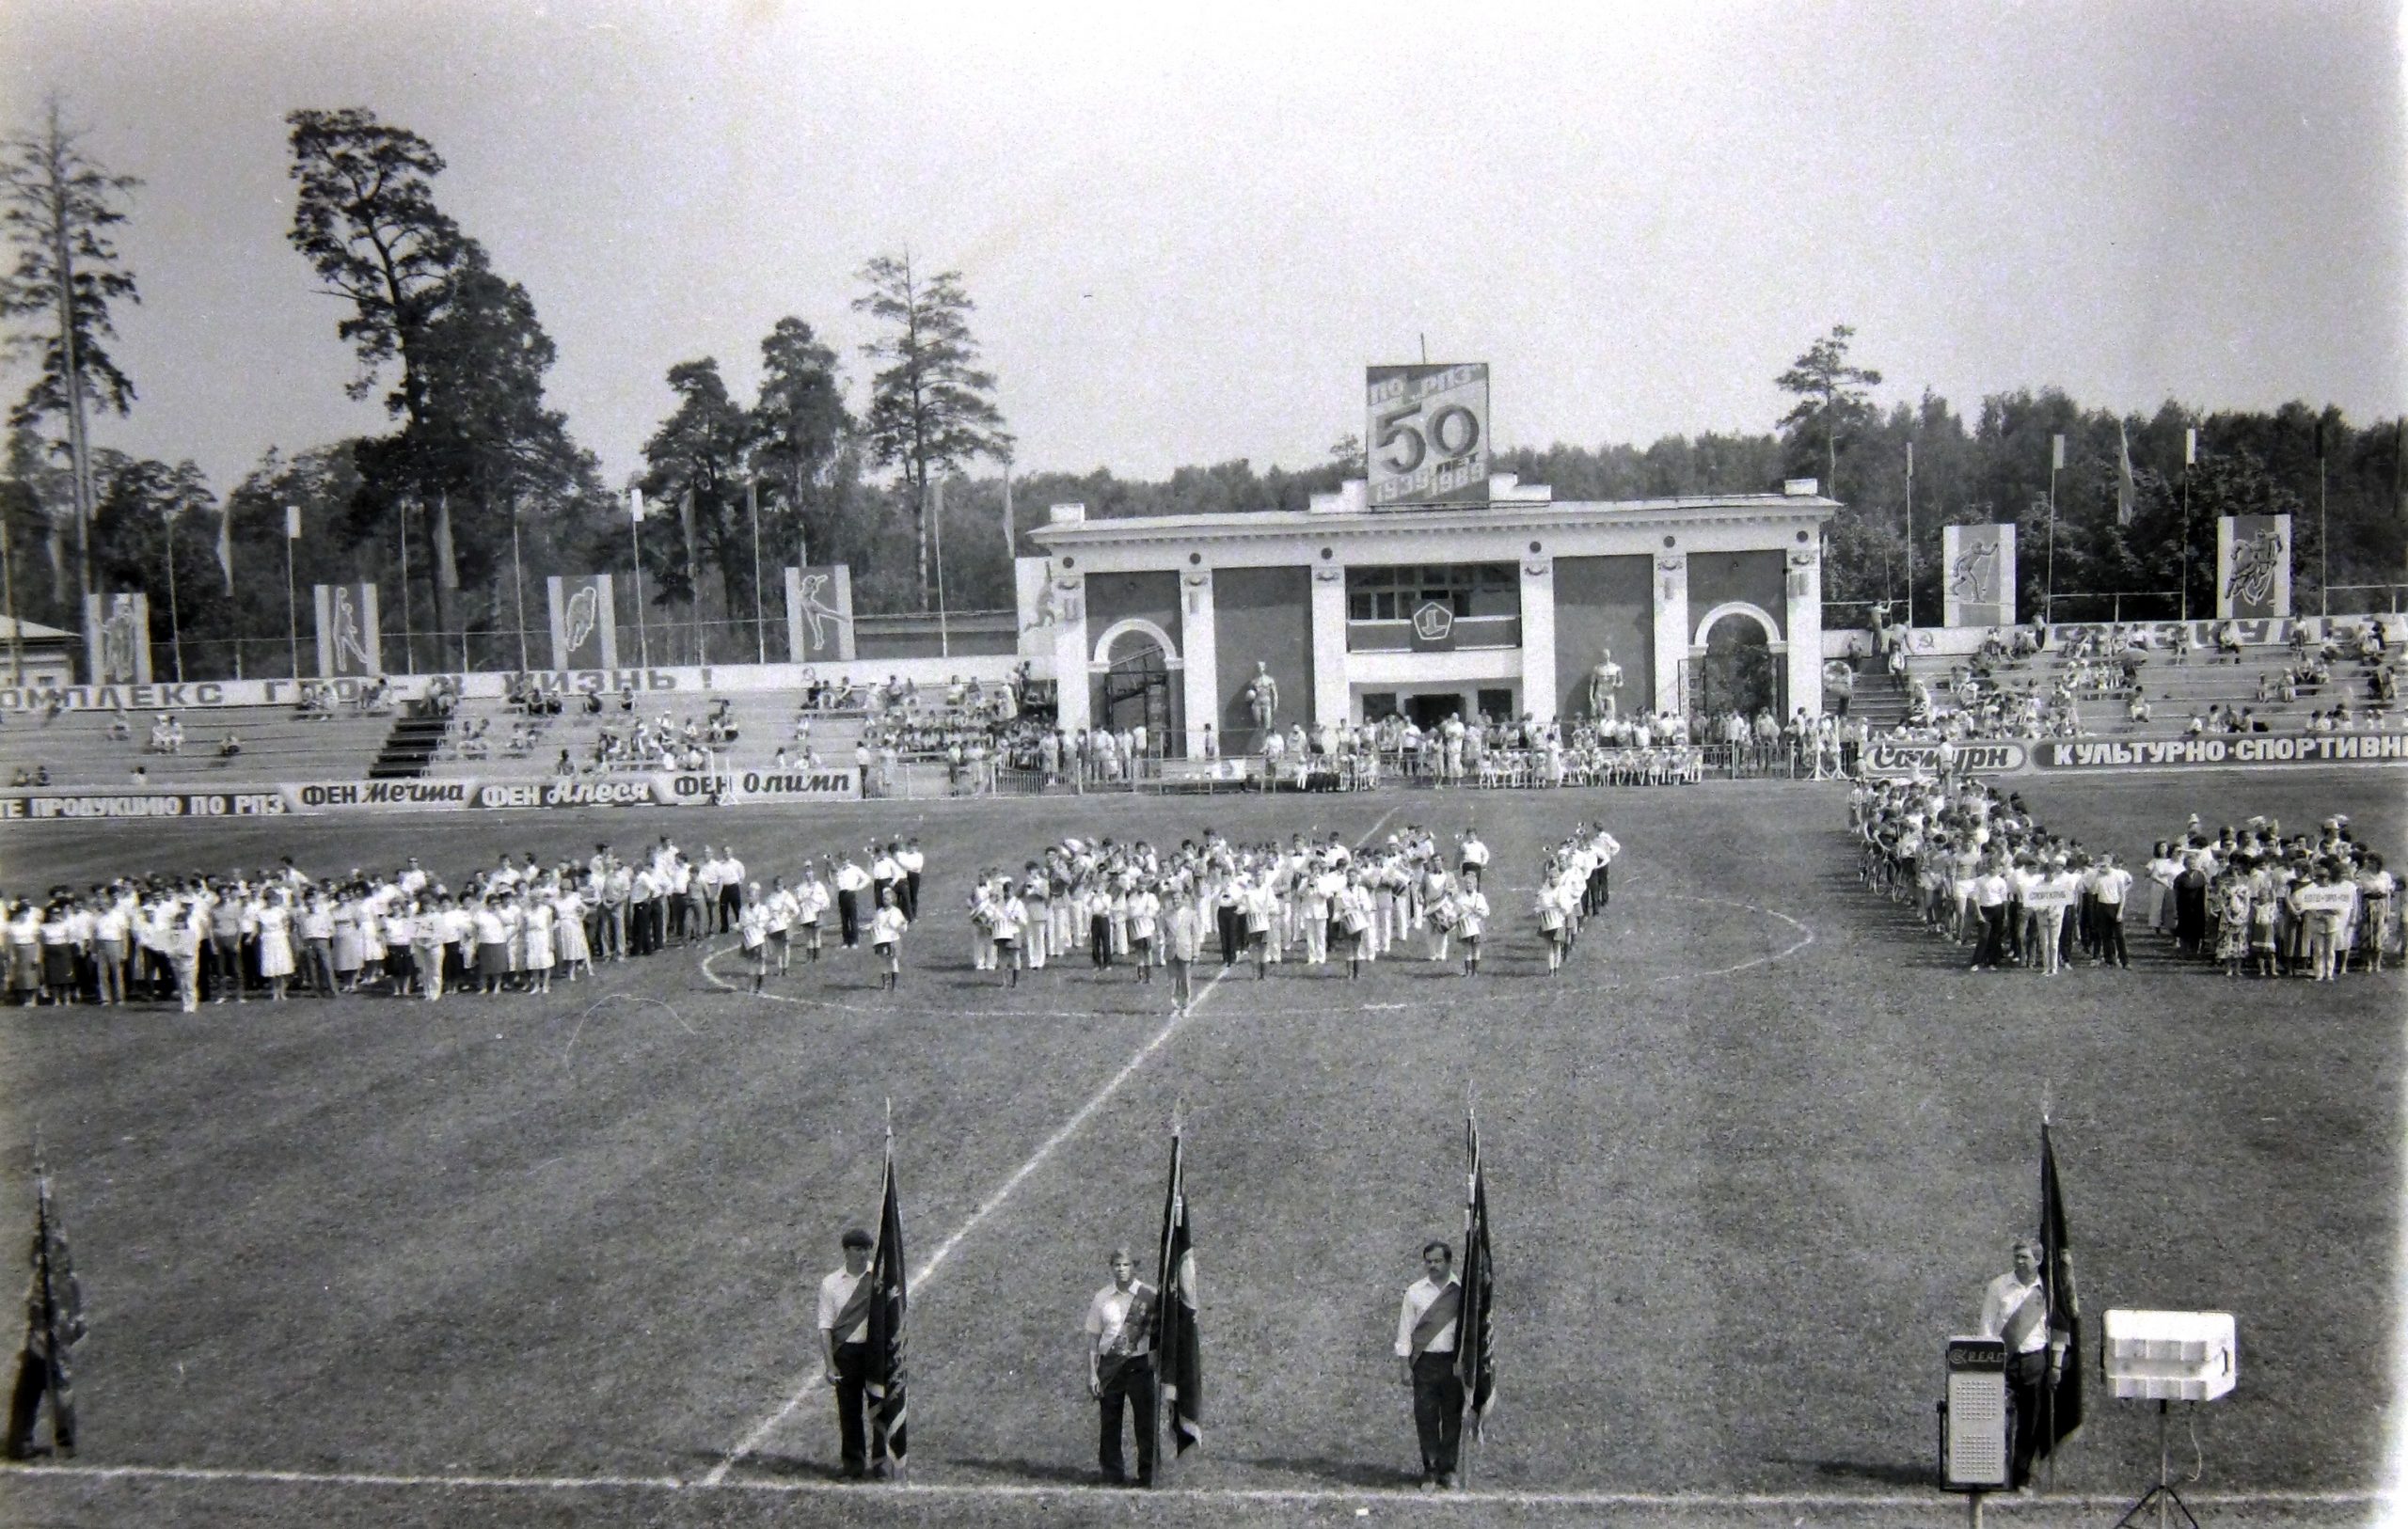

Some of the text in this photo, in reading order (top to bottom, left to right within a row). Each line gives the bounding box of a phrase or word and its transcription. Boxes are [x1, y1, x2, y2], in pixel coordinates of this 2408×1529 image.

[1375, 402, 1480, 475] 50
[1376, 462, 1485, 503] 1939 1989
[302, 781, 465, 806] ФЕН Мечта
[482, 774, 650, 807] ФЕН Алеся
[673, 772, 849, 796] ФЕН Олимп
[31, 797, 182, 816] ПРОДУКЦИЮ
[190, 795, 226, 815] ПО
[235, 795, 285, 813] РПЗ
